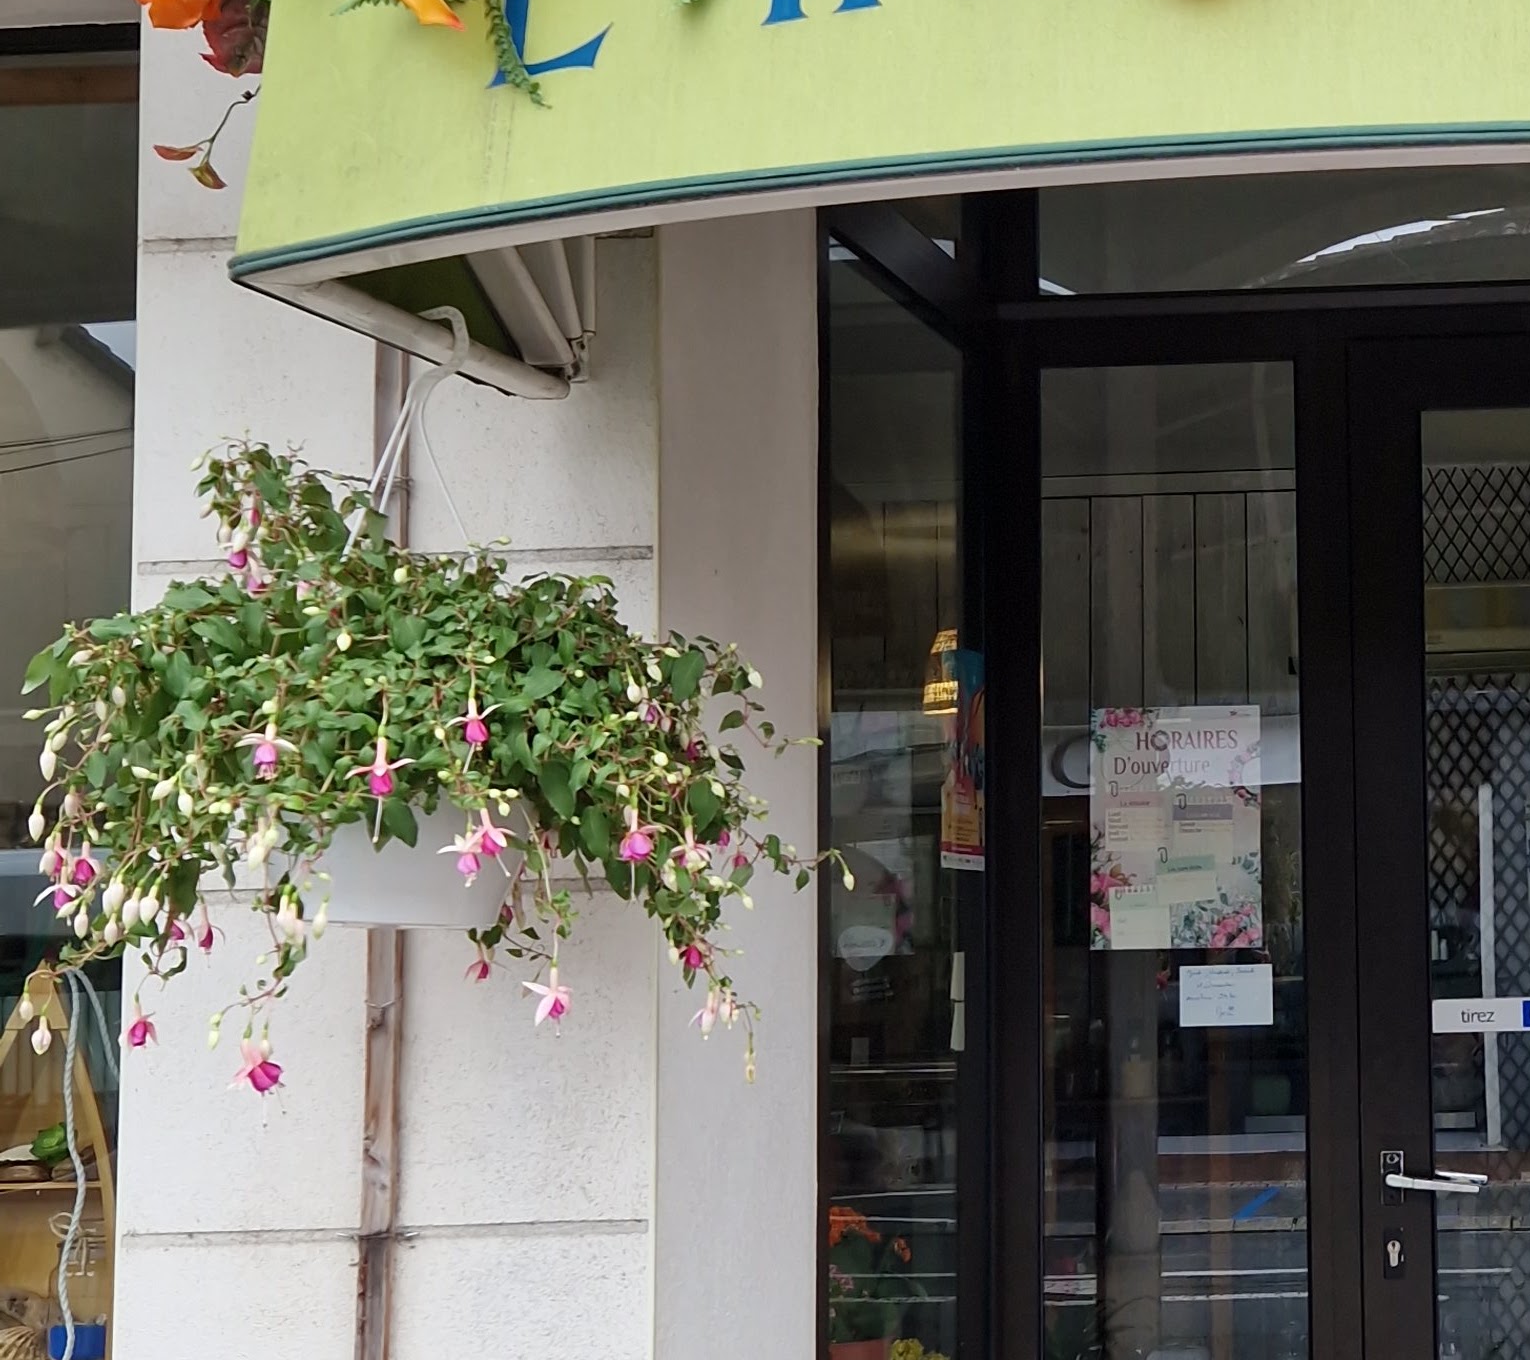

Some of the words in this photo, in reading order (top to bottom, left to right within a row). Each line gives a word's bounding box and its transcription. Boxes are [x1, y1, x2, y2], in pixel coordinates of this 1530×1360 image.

[1136, 730, 1238, 752] HORAIRES
[1114, 756, 1210, 775] D'ouverture
[1461, 1009, 1496, 1023] tirez
